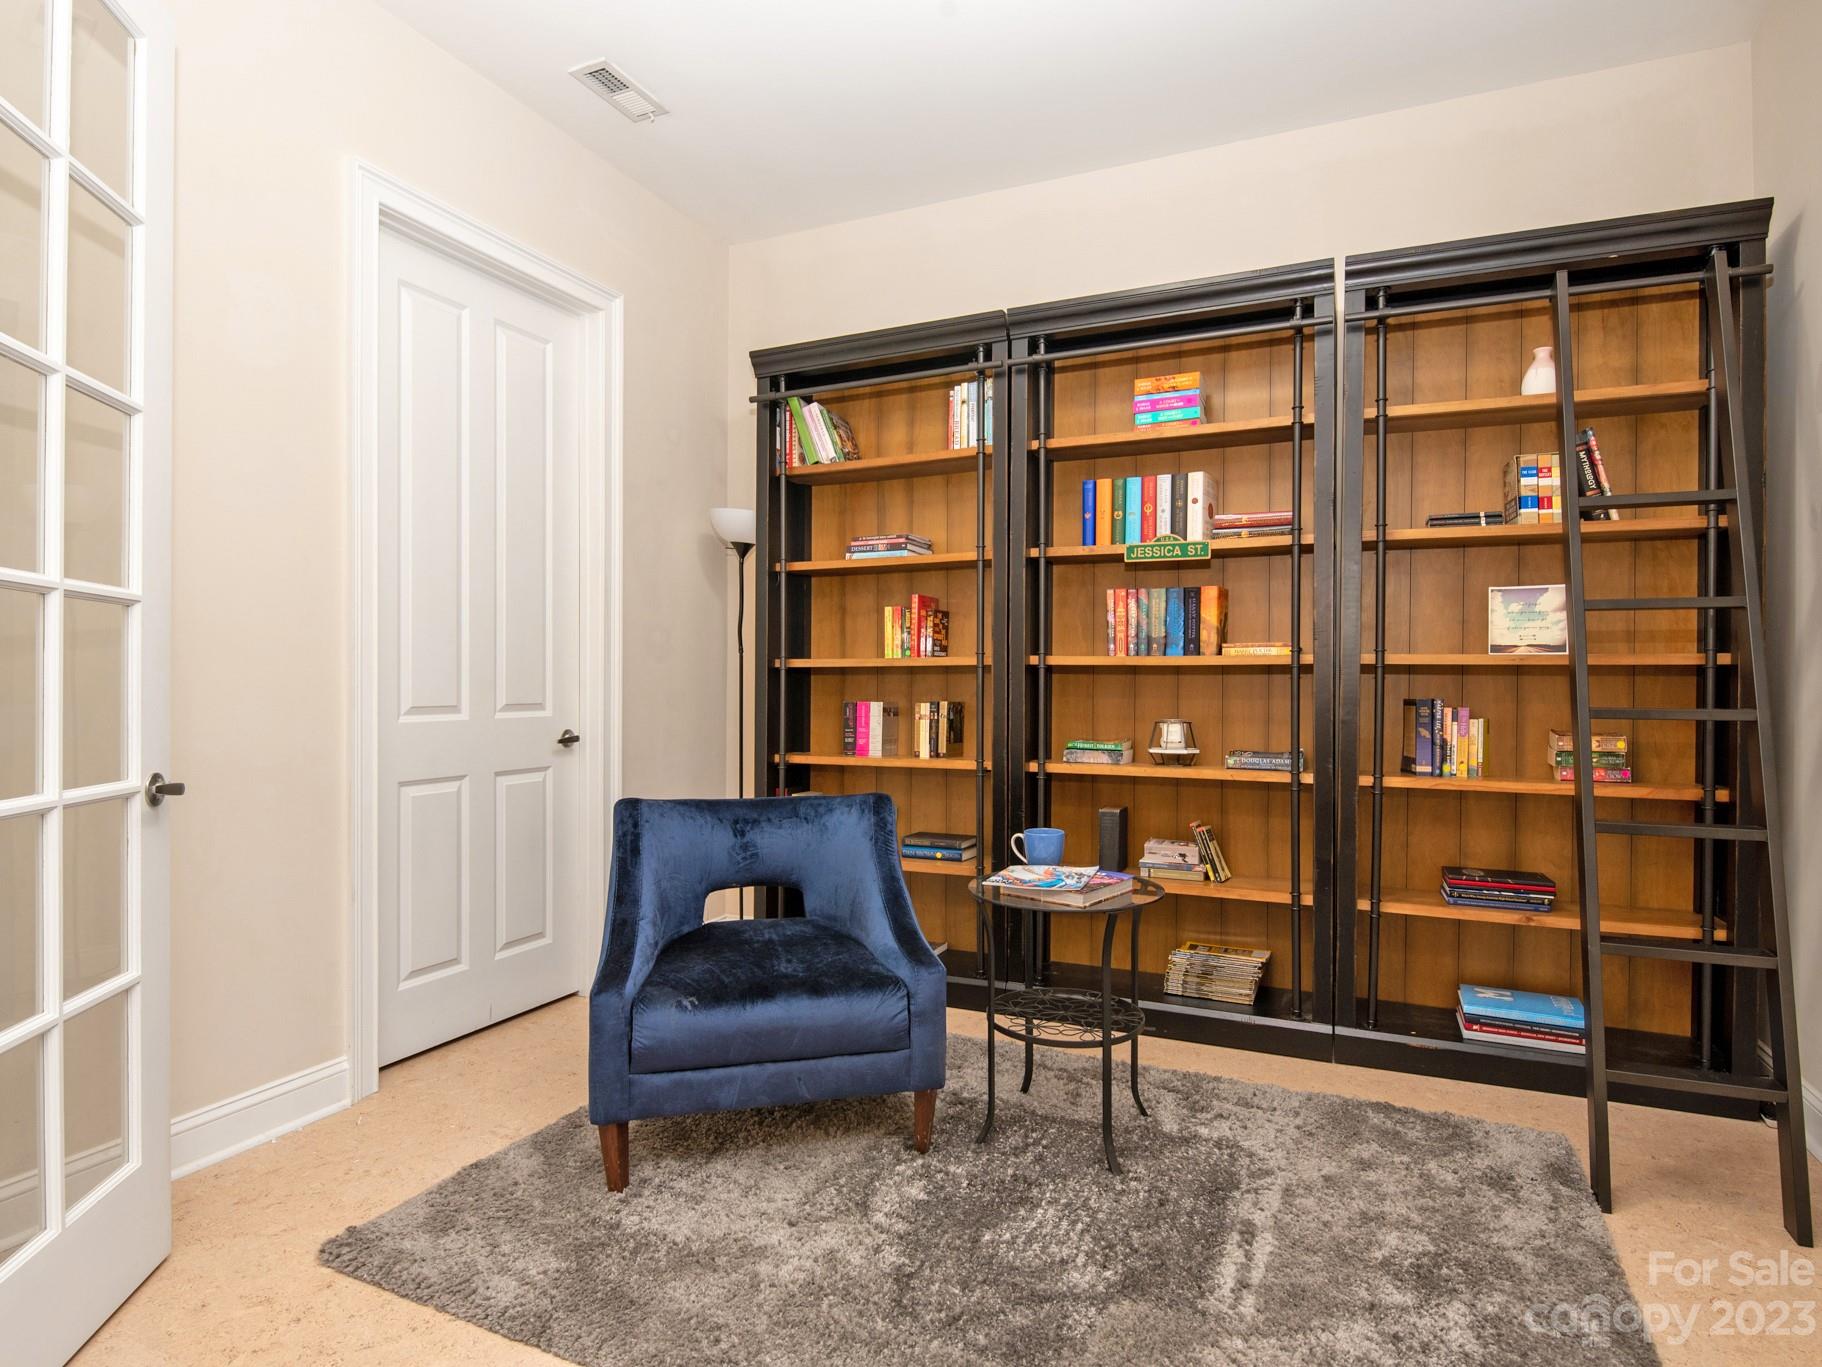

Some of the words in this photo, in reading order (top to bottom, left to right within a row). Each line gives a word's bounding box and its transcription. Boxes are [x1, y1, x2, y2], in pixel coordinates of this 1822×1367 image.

[1579, 450, 1598, 490] MYTHOLOGY
[1130, 545, 1182, 559] JESSICA
[1187, 544, 1204, 556] ST.
[1241, 757, 1270, 765] DOUGLAS
